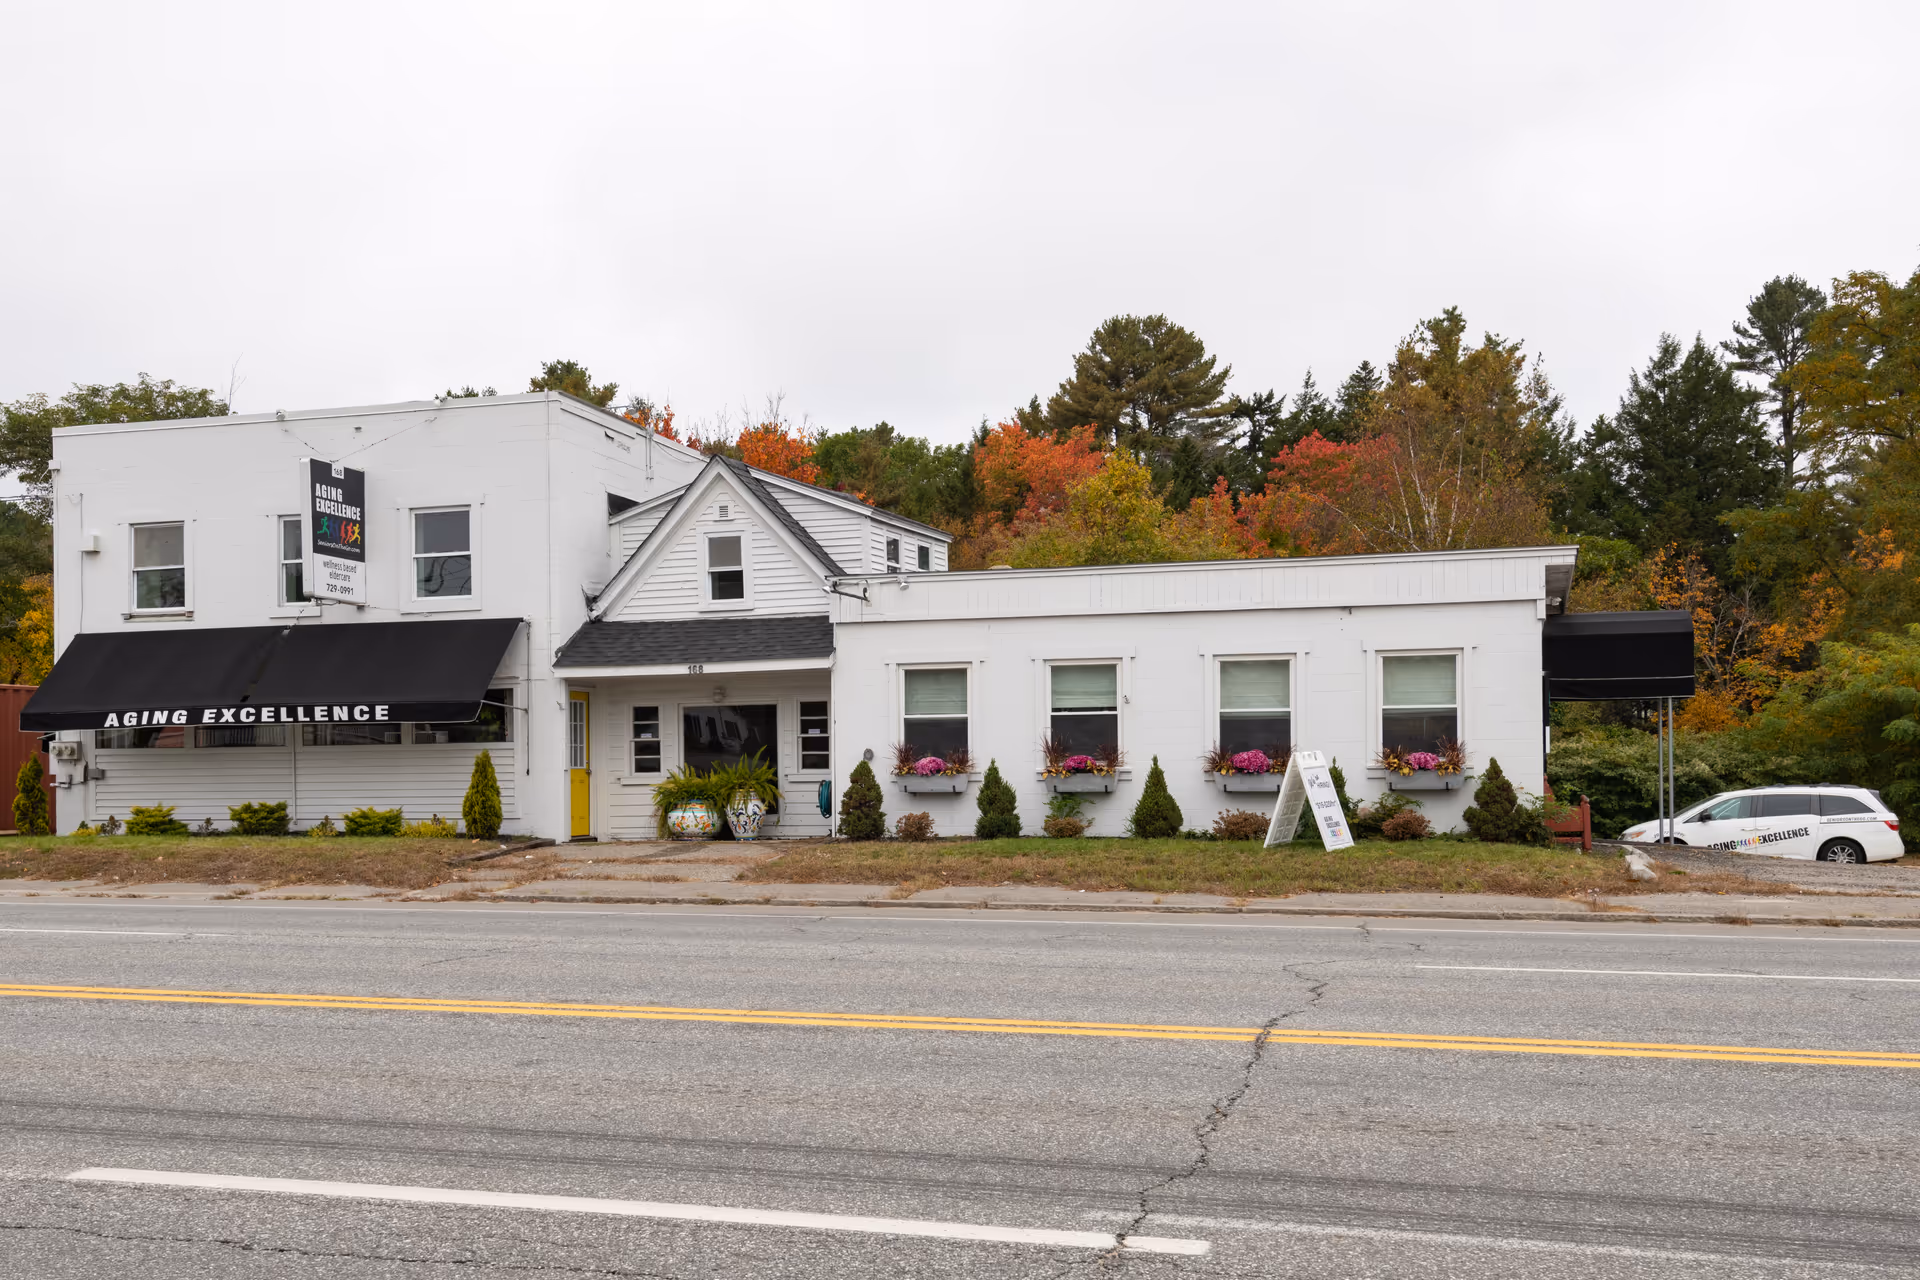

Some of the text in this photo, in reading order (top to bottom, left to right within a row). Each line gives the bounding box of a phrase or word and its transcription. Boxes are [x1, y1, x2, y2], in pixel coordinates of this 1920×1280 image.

[333, 467, 343, 477] 168
[315, 483, 343, 502] AGING
[316, 498, 361, 521] EXCELLENCE
[323, 560, 357, 574] wellness based
[329, 570, 351, 582] eldercare
[326, 583, 354, 596] 729-0991
[687, 664, 704, 676] 168
[104, 704, 390, 728] AGING EXCELLENCE
[1758, 827, 1810, 844] EXCELLENCE
